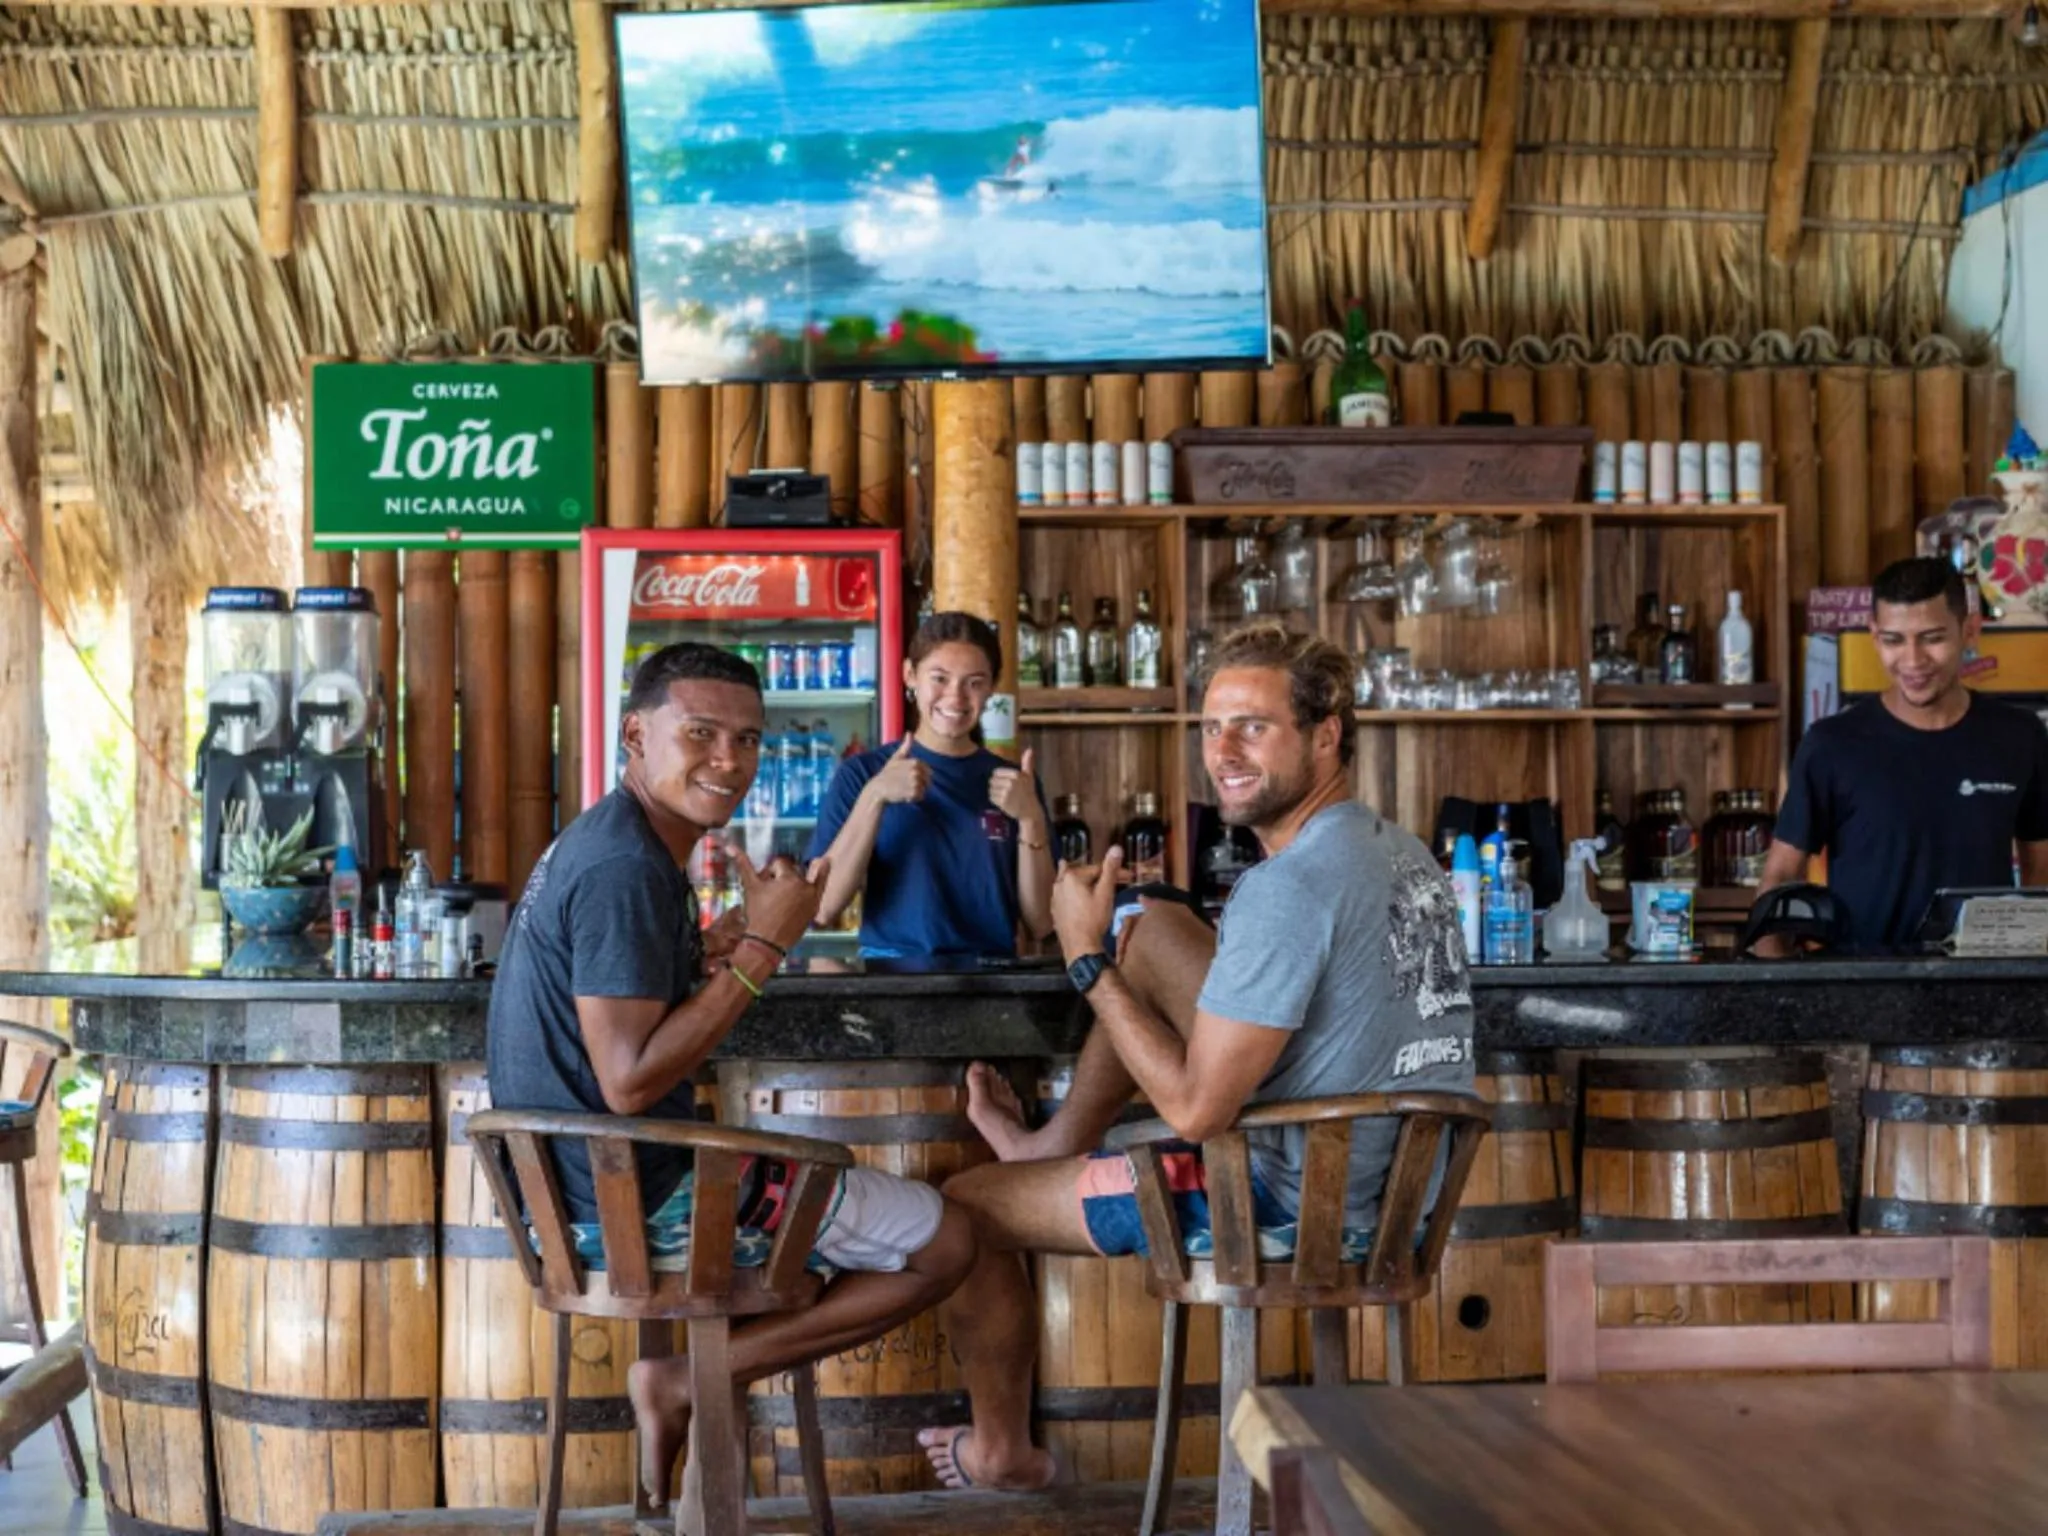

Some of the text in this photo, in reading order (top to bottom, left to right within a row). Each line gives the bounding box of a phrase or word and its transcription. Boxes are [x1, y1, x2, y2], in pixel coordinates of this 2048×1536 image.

[412, 383, 499, 399] CERVEZA
[360, 406, 540, 480] Toña
[384, 497, 526, 514] NICARAGUA
[633, 564, 767, 607] Coca-Cola
[1808, 611, 1836, 629] TIP
